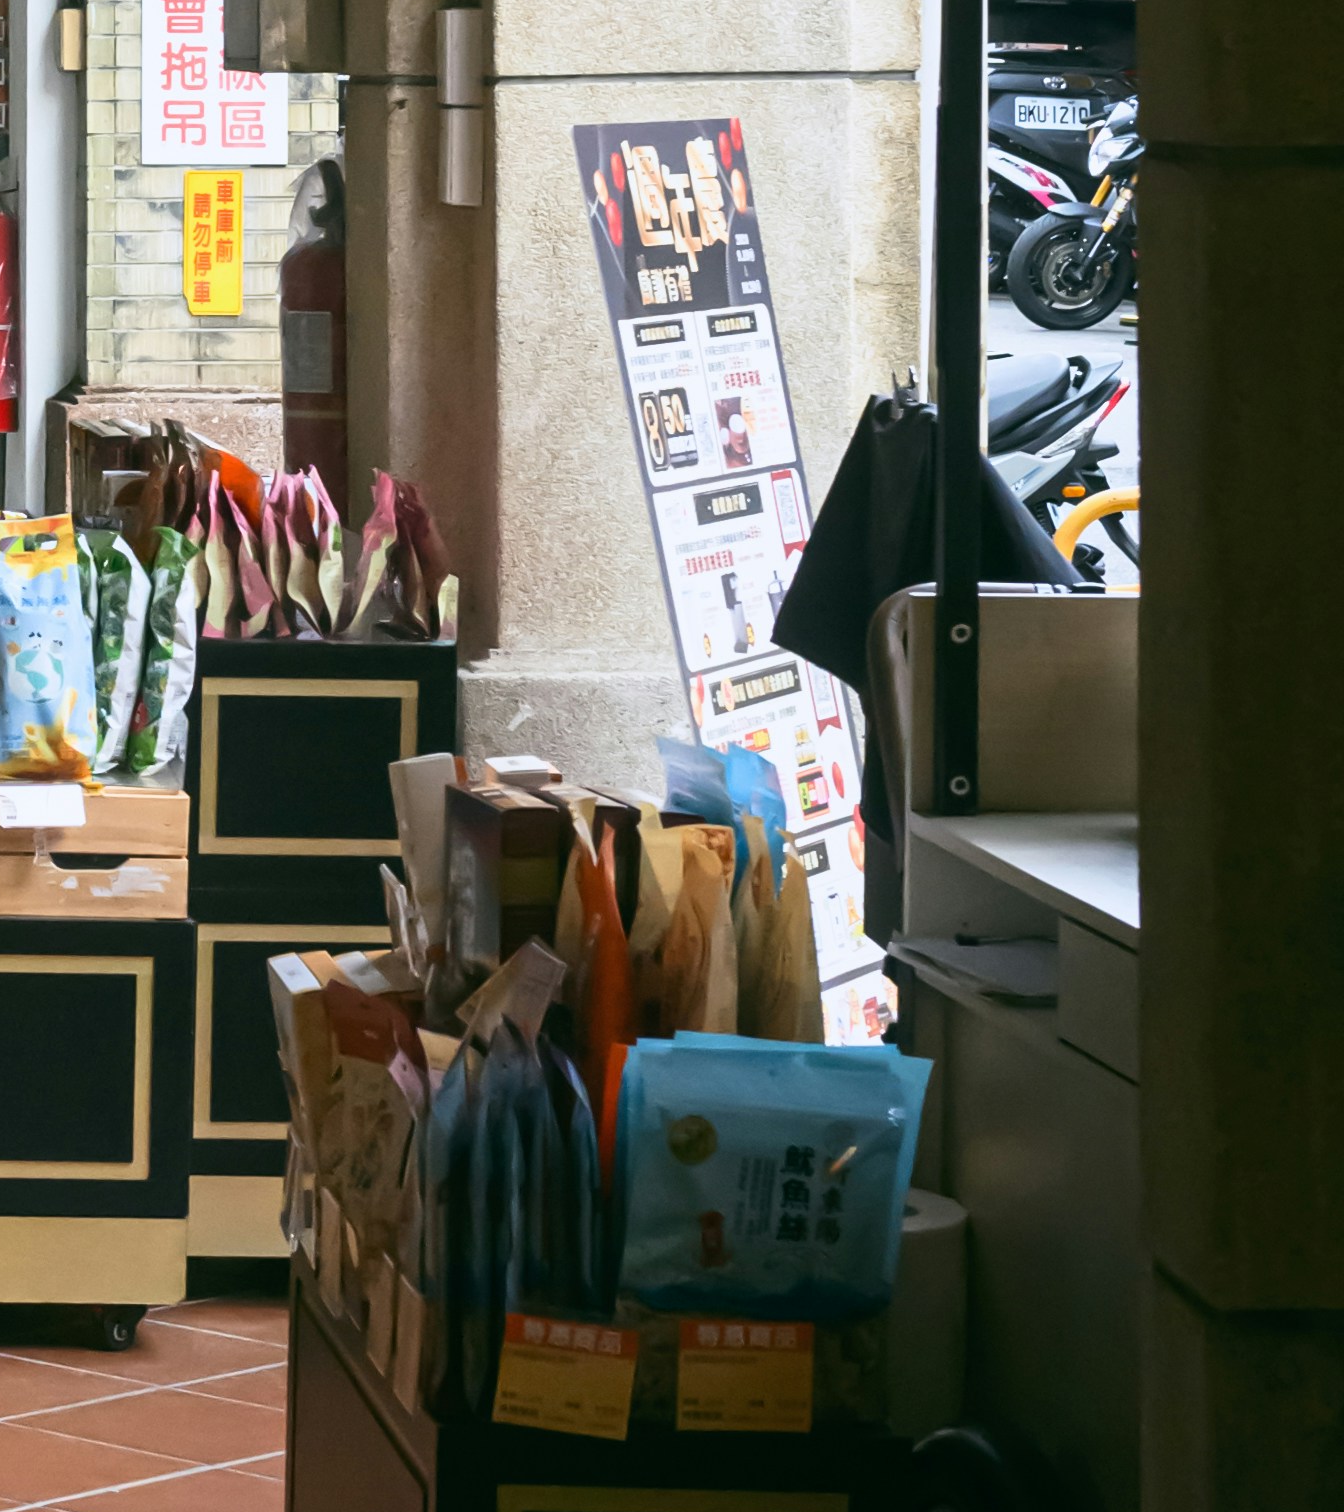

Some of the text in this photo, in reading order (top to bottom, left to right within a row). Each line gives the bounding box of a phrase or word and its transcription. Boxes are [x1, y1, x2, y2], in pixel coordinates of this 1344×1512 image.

[192, 192, 212, 306] 請勿停車
[216, 178, 235, 264] 車庫前
